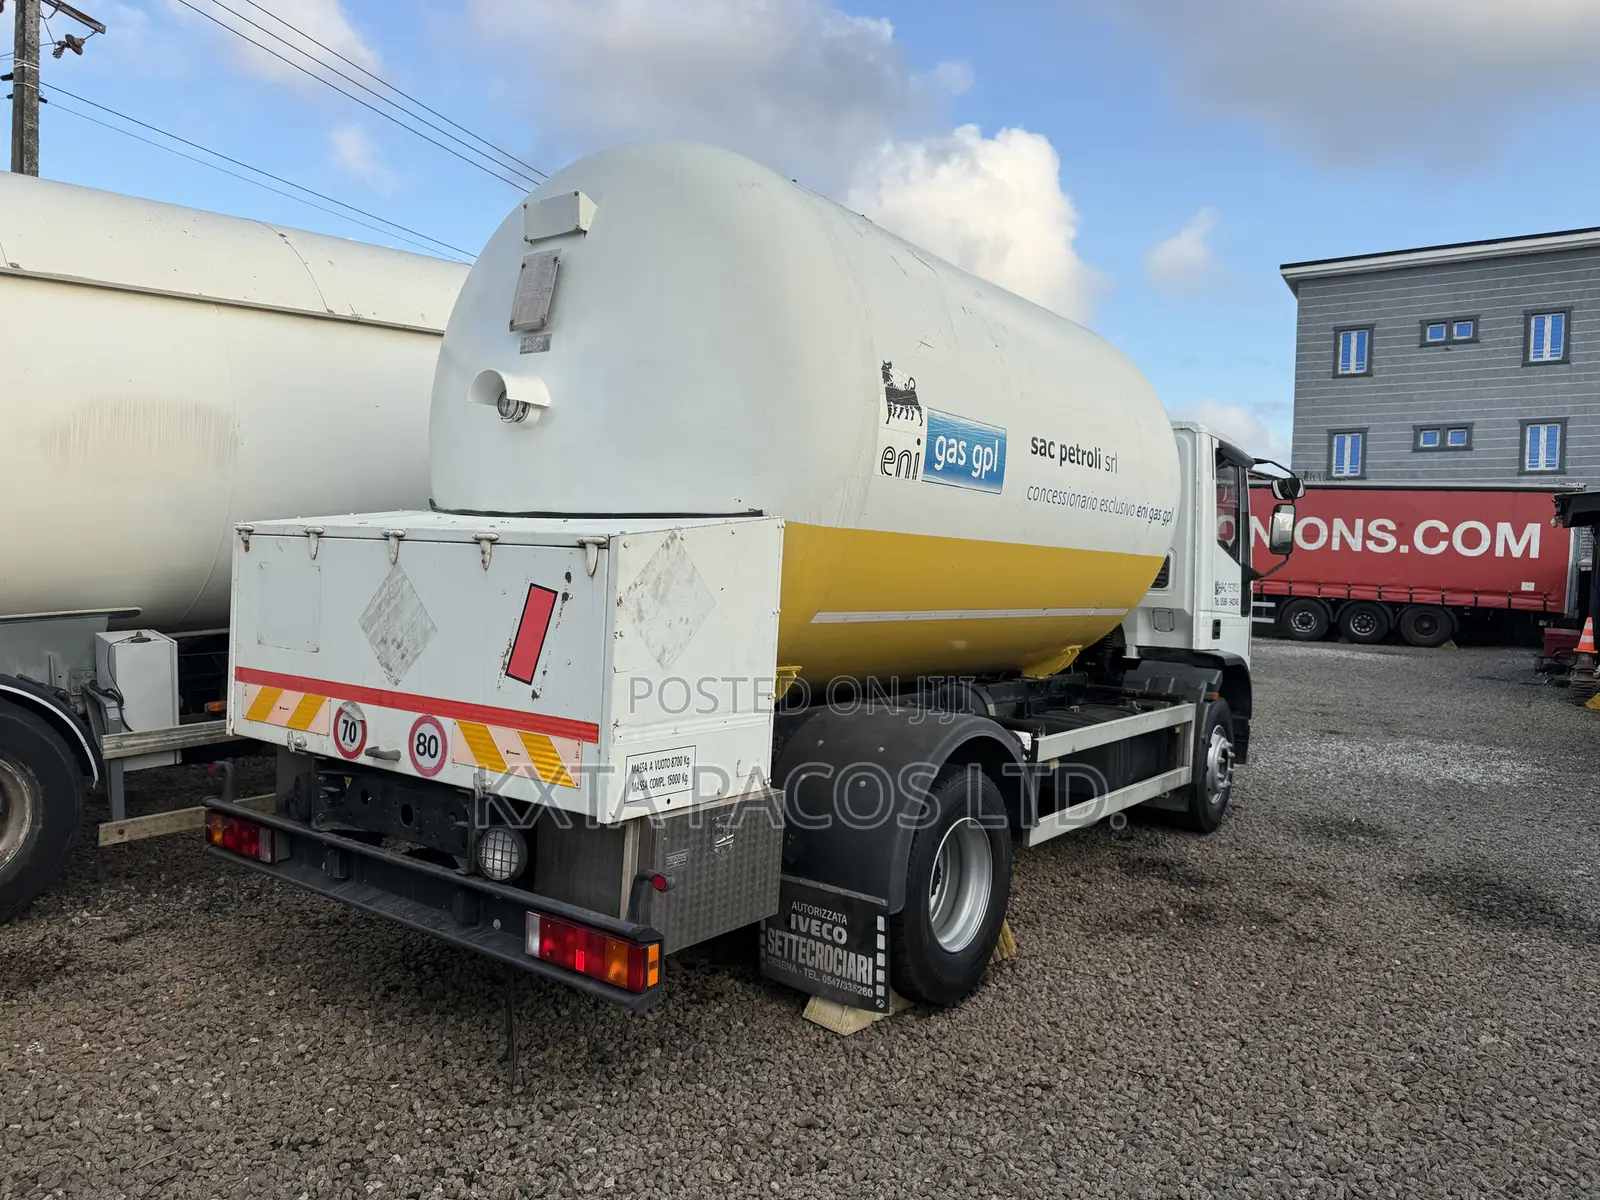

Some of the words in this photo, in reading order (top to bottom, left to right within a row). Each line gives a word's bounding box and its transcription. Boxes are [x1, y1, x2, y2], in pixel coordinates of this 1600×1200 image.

[880, 437, 921, 481] eni
[934, 435, 967, 471] gas
[971, 439, 999, 479] gpl
[1030, 436, 1056, 459] sac
[1059, 443, 1101, 469] petroli
[1104, 451, 1118, 474] srl
[1026, 485, 1098, 511] concessionario
[1099, 496, 1135, 517] esclusivo
[1136, 501, 1148, 519] eni
[1149, 508, 1162, 524] gas
[1162, 506, 1174, 526] gpl
[342, 719, 357, 743] 70
[415, 732, 438, 759] 80
[631, 762, 648, 774] MASSA
[649, 760, 654, 772] A
[655, 757, 671, 771] VUOTO
[671, 755, 683, 768] 8700
[631, 779, 648, 792] MASSA
[667, 773, 681, 786] 15000
[791, 900, 848, 926] AUTORIZZATA
[790, 913, 848, 945] IVECO
[767, 927, 874, 986] SETTECROCIARI
[767, 955, 798, 974] CESENA
